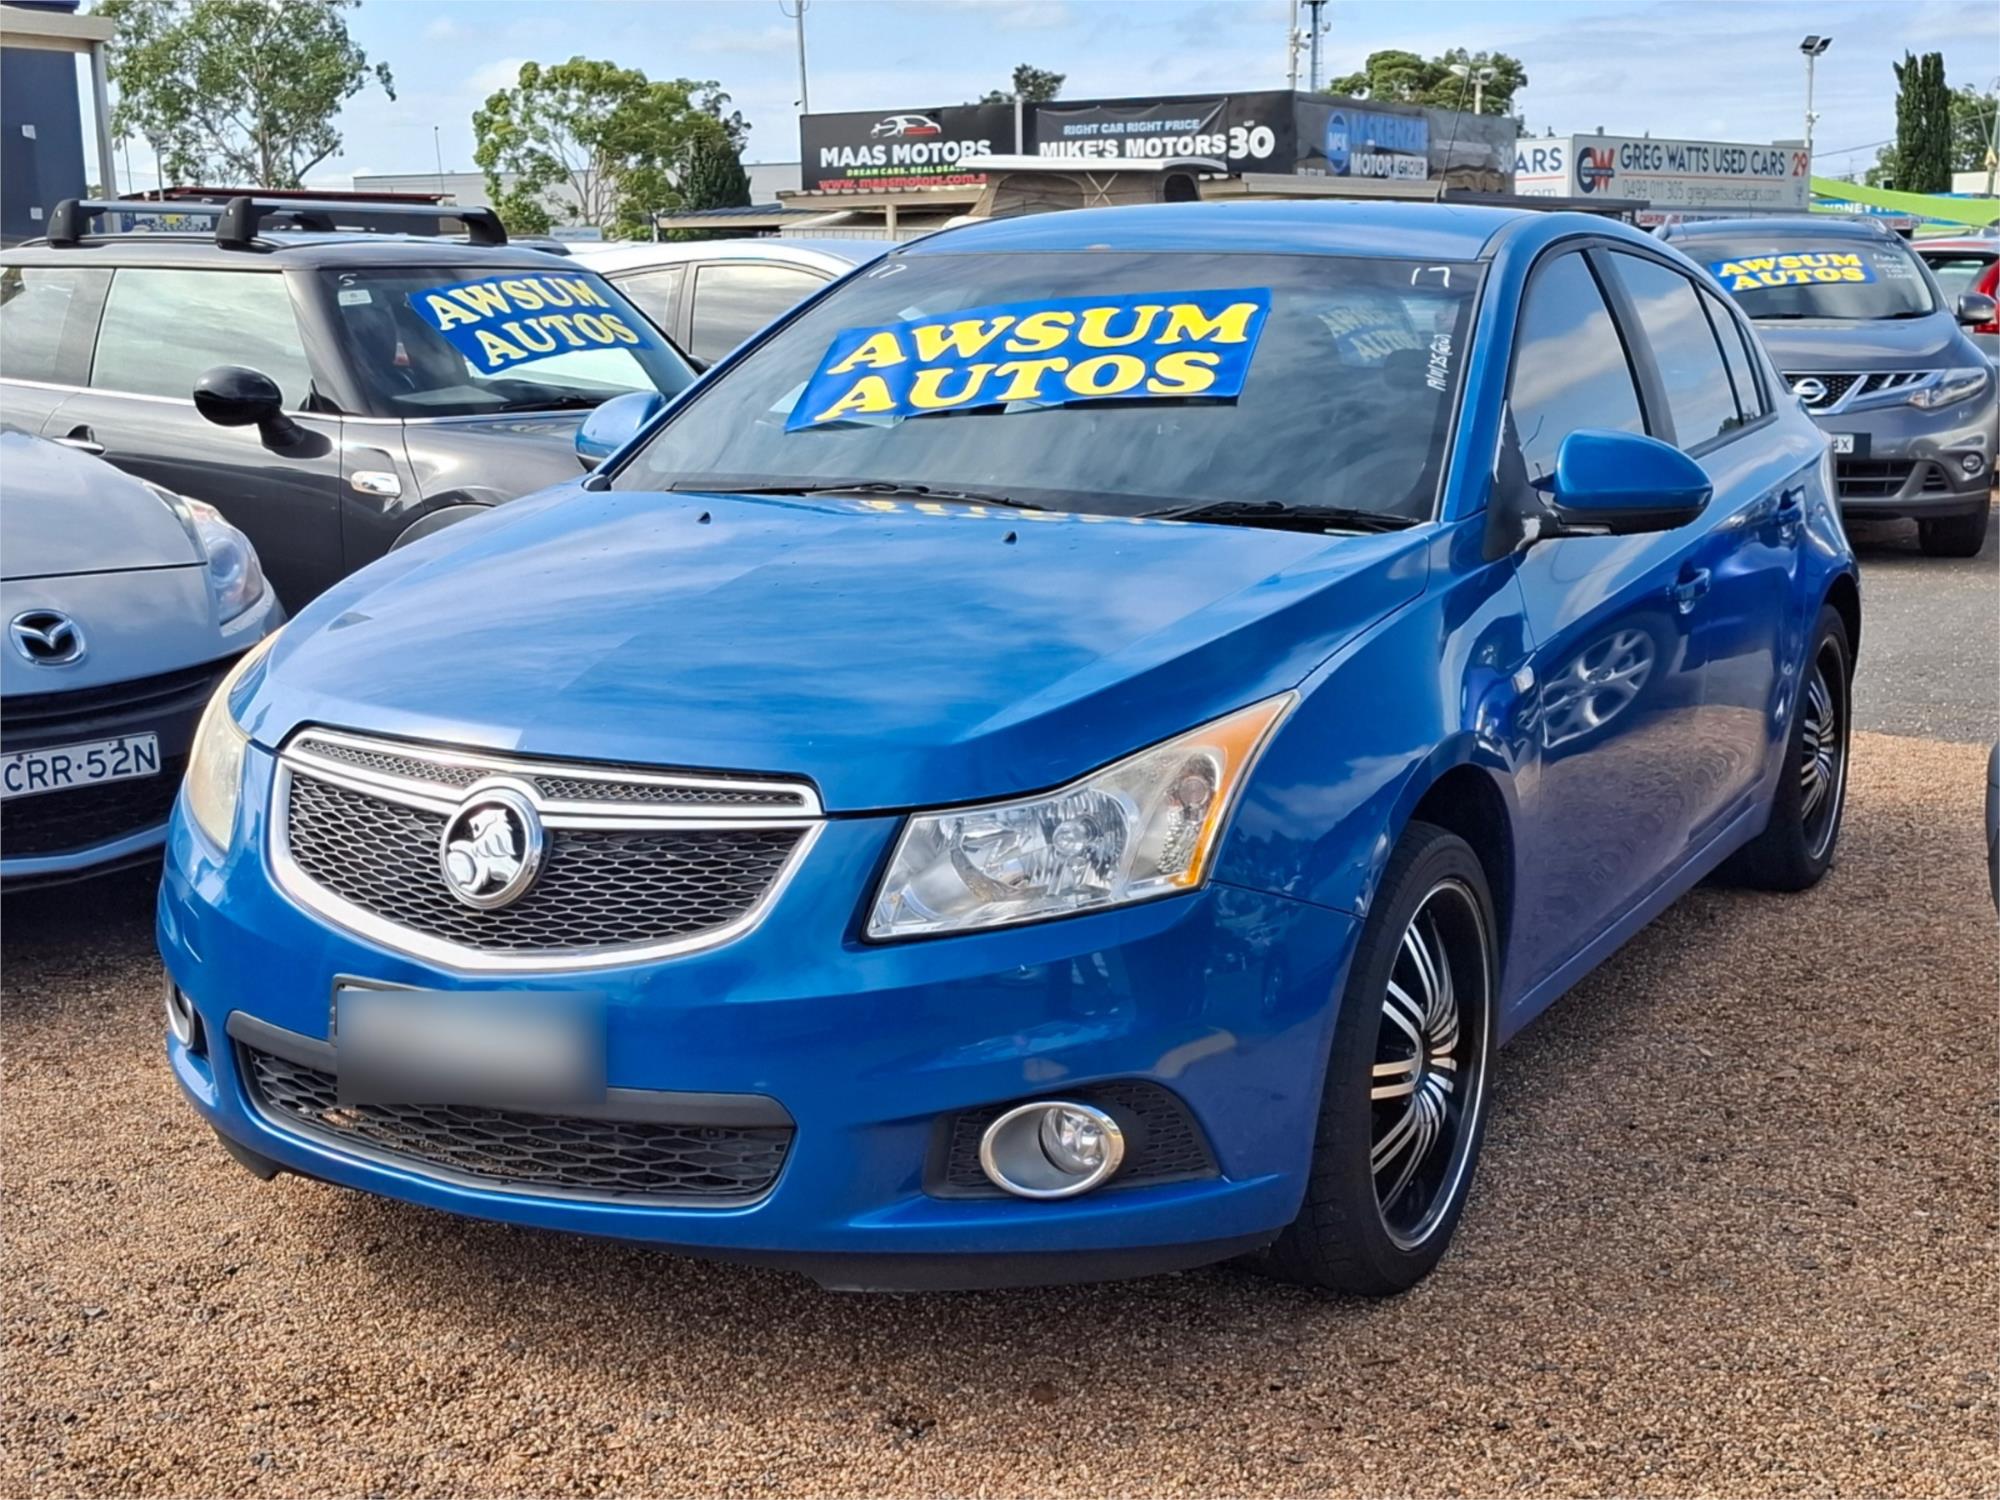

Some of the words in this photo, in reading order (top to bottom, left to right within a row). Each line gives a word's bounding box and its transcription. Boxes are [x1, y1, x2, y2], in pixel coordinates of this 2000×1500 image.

[1063, 124, 1097, 135] RIGHT
[1100, 122, 1124, 134] CAR
[1126, 121, 1162, 133] RIGHT
[1165, 119, 1200, 131] PRICE
[820, 145, 887, 168] MAAS
[892, 139, 991, 166] MOTORS
[1039, 139, 1118, 158] MIKE'S
[1125, 134, 1227, 158] MOTORS
[1228, 126, 1275, 159] 30
[846, 168, 879, 178] DREAM
[910, 166, 934, 174] REAL
[1350, 152, 1393, 177] MOTOR
[1620, 143, 1663, 170] GREG
[1665, 146, 1709, 173] WATTS
[1713, 149, 1747, 175] USED
[1751, 150, 1785, 176] CARS
[1791, 152, 1808, 177] 29
[1719, 253, 1863, 277] AWSUM
[1732, 267, 1865, 291] AUTOS
[426, 278, 610, 331] AWSUM
[475, 313, 639, 366] AUTOS
[827, 303, 1258, 375] AWSUM
[814, 351, 1220, 421] AUTOS
